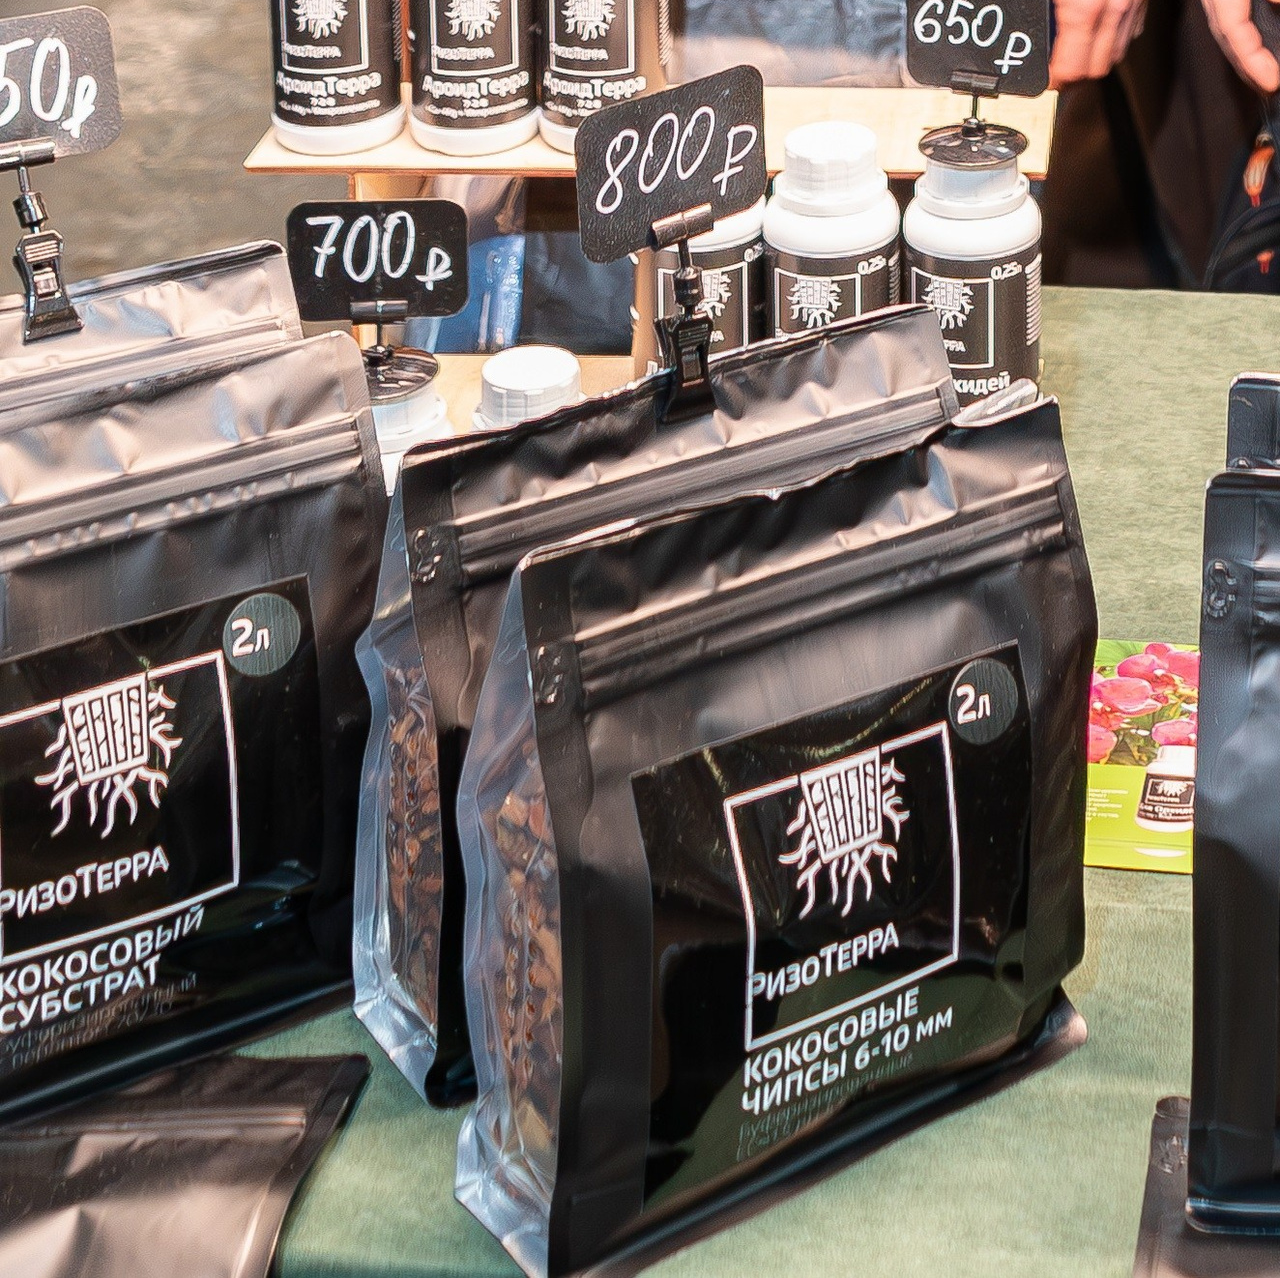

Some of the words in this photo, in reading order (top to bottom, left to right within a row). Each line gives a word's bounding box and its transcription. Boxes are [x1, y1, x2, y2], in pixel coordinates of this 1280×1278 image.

[231, 617, 270, 657] 2л
[957, 684, 991, 725] 2л
[0, 903, 205, 1002] КОКОСОВЫЙ
[0, 953, 162, 1035] СУБСТРАТ
[742, 1049, 847, 1116] ЧИПСЫ
[854, 1023, 910, 1071] 6-10
[744, 985, 920, 1089] КОКОСОВЫЕ
